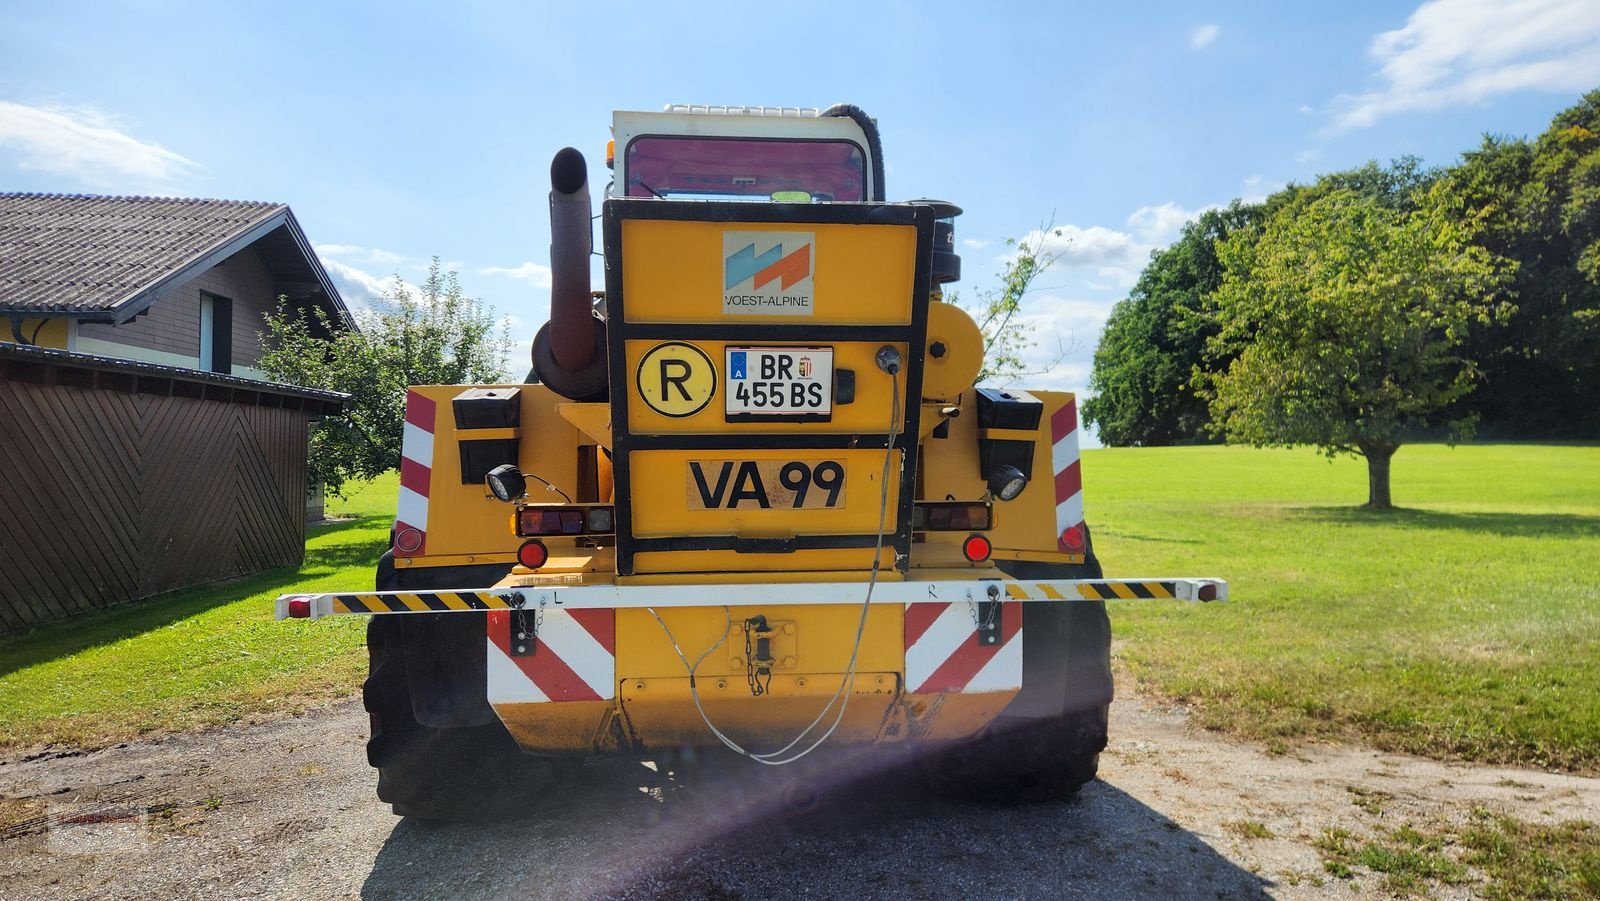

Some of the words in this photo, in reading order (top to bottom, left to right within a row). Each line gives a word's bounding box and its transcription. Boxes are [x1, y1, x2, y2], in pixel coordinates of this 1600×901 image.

[725, 295, 808, 306] VOEST-ALPINE
[735, 370, 742, 378] A
[761, 354, 793, 380] BR
[660, 359, 693, 401] R
[736, 382, 784, 407] 455
[791, 382, 822, 407] BS
[689, 461, 771, 508] VA
[779, 460, 845, 508] 99
[554, 591, 563, 604] L
[928, 584, 938, 599] R
